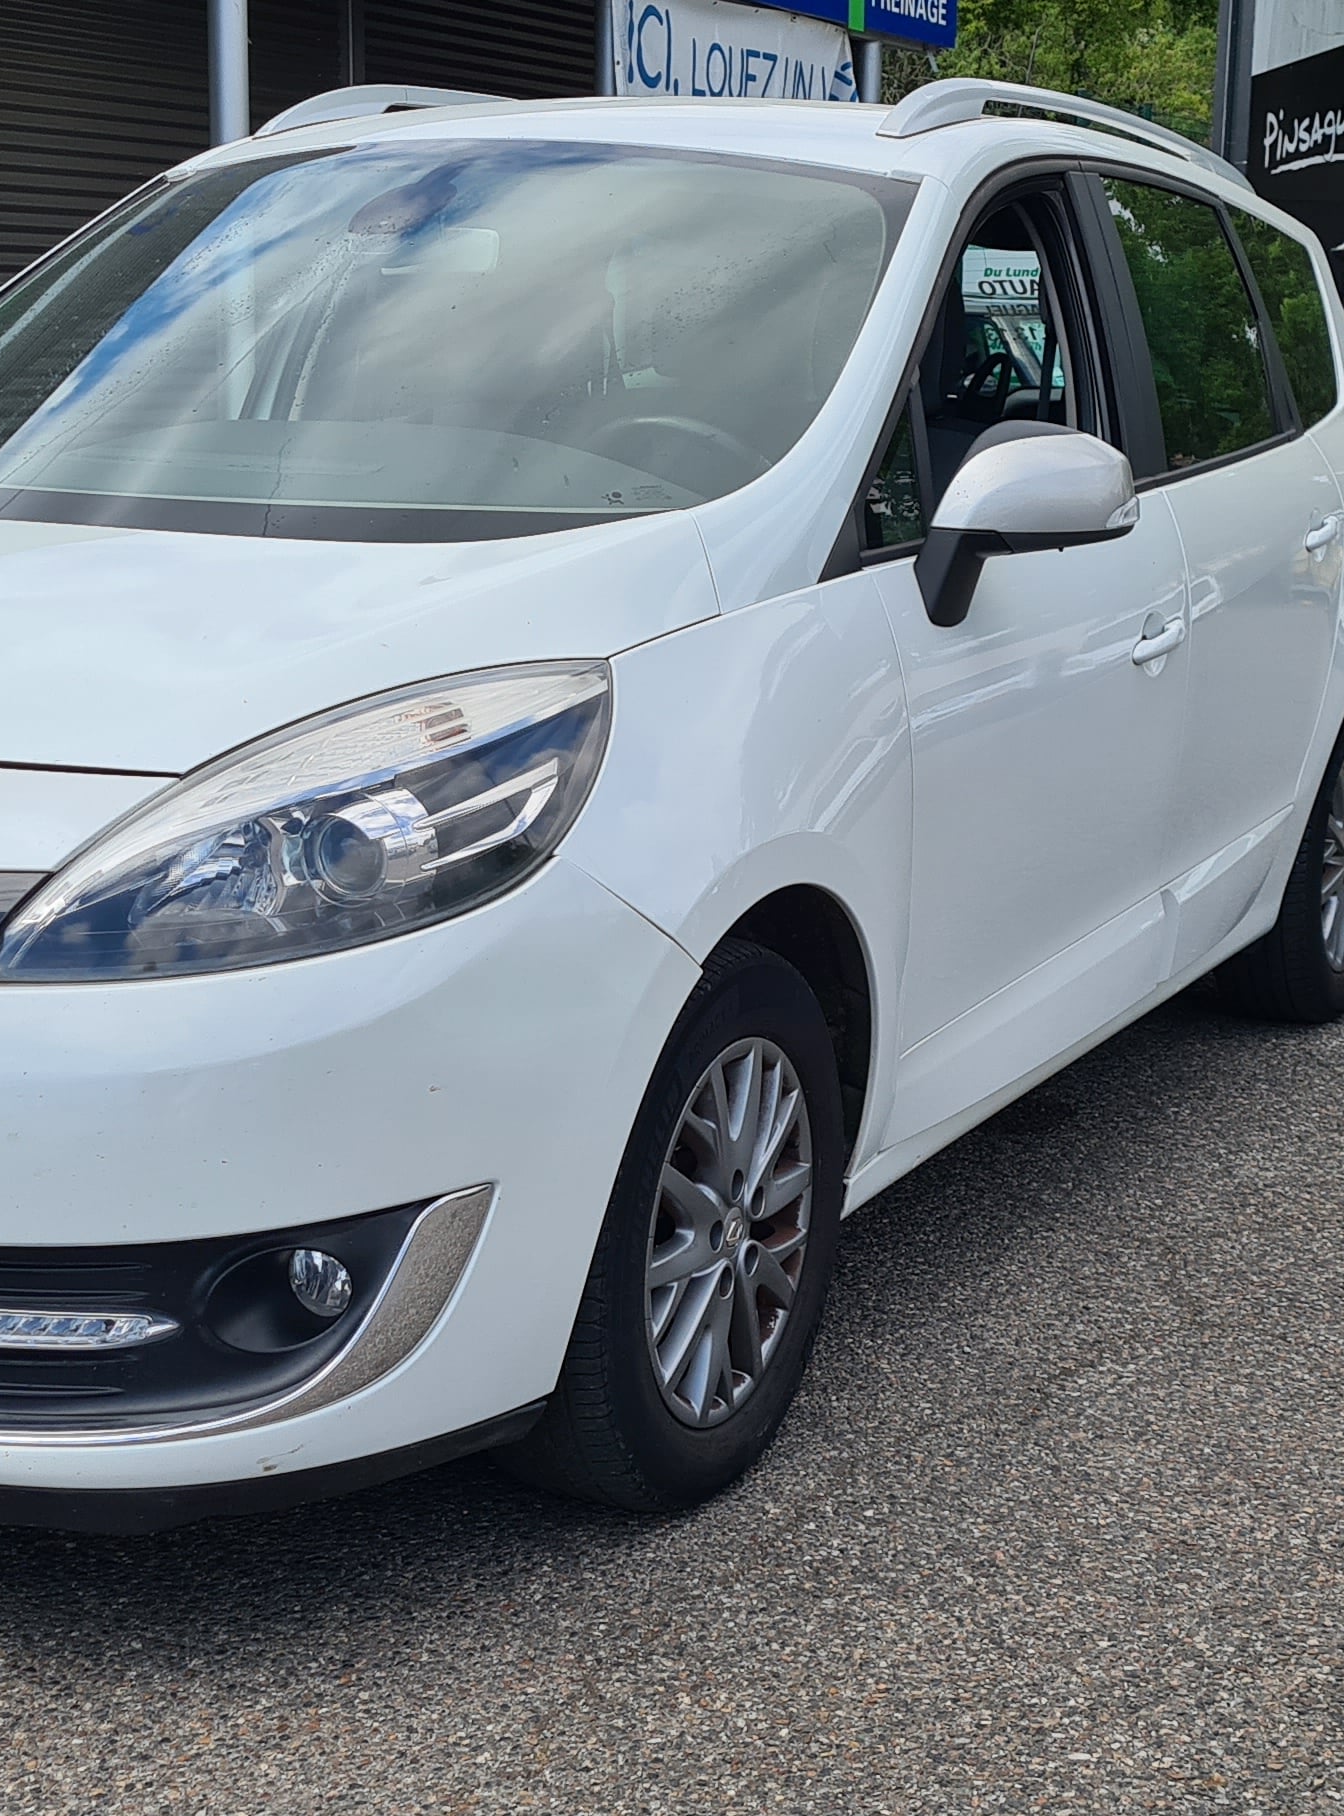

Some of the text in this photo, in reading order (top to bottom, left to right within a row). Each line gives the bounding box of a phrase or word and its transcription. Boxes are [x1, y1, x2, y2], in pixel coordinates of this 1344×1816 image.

[871, 0, 947, 26] EINAGE
[628, 0, 679, 96] ICI,
[692, 38, 778, 98] LOUEZ
